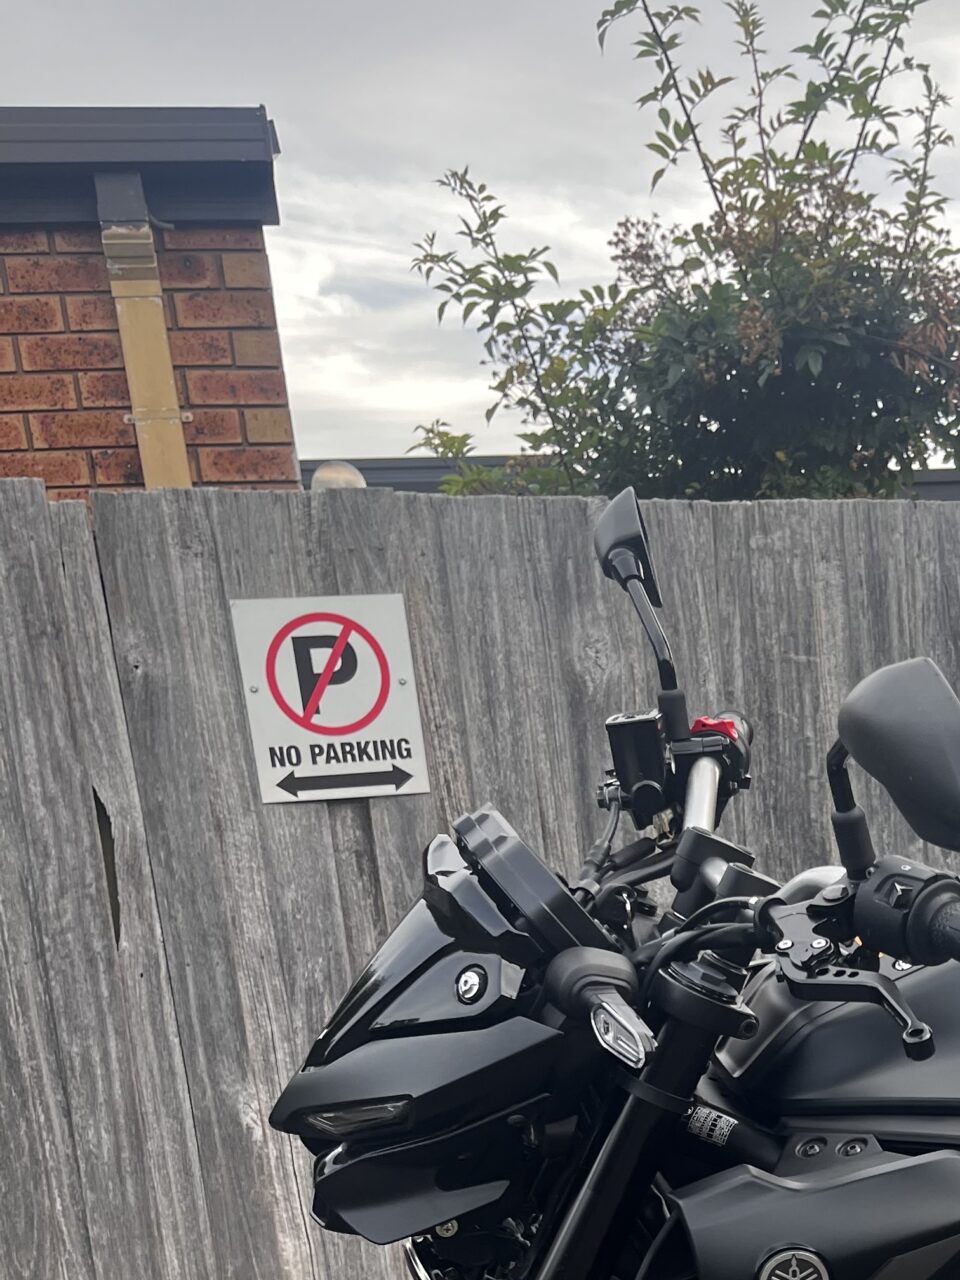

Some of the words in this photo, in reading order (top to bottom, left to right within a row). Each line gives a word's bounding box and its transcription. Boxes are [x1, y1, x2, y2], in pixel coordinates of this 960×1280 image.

[291, 634, 358, 715] P
[268, 745, 301, 768] NO
[309, 738, 412, 765] PARKING
